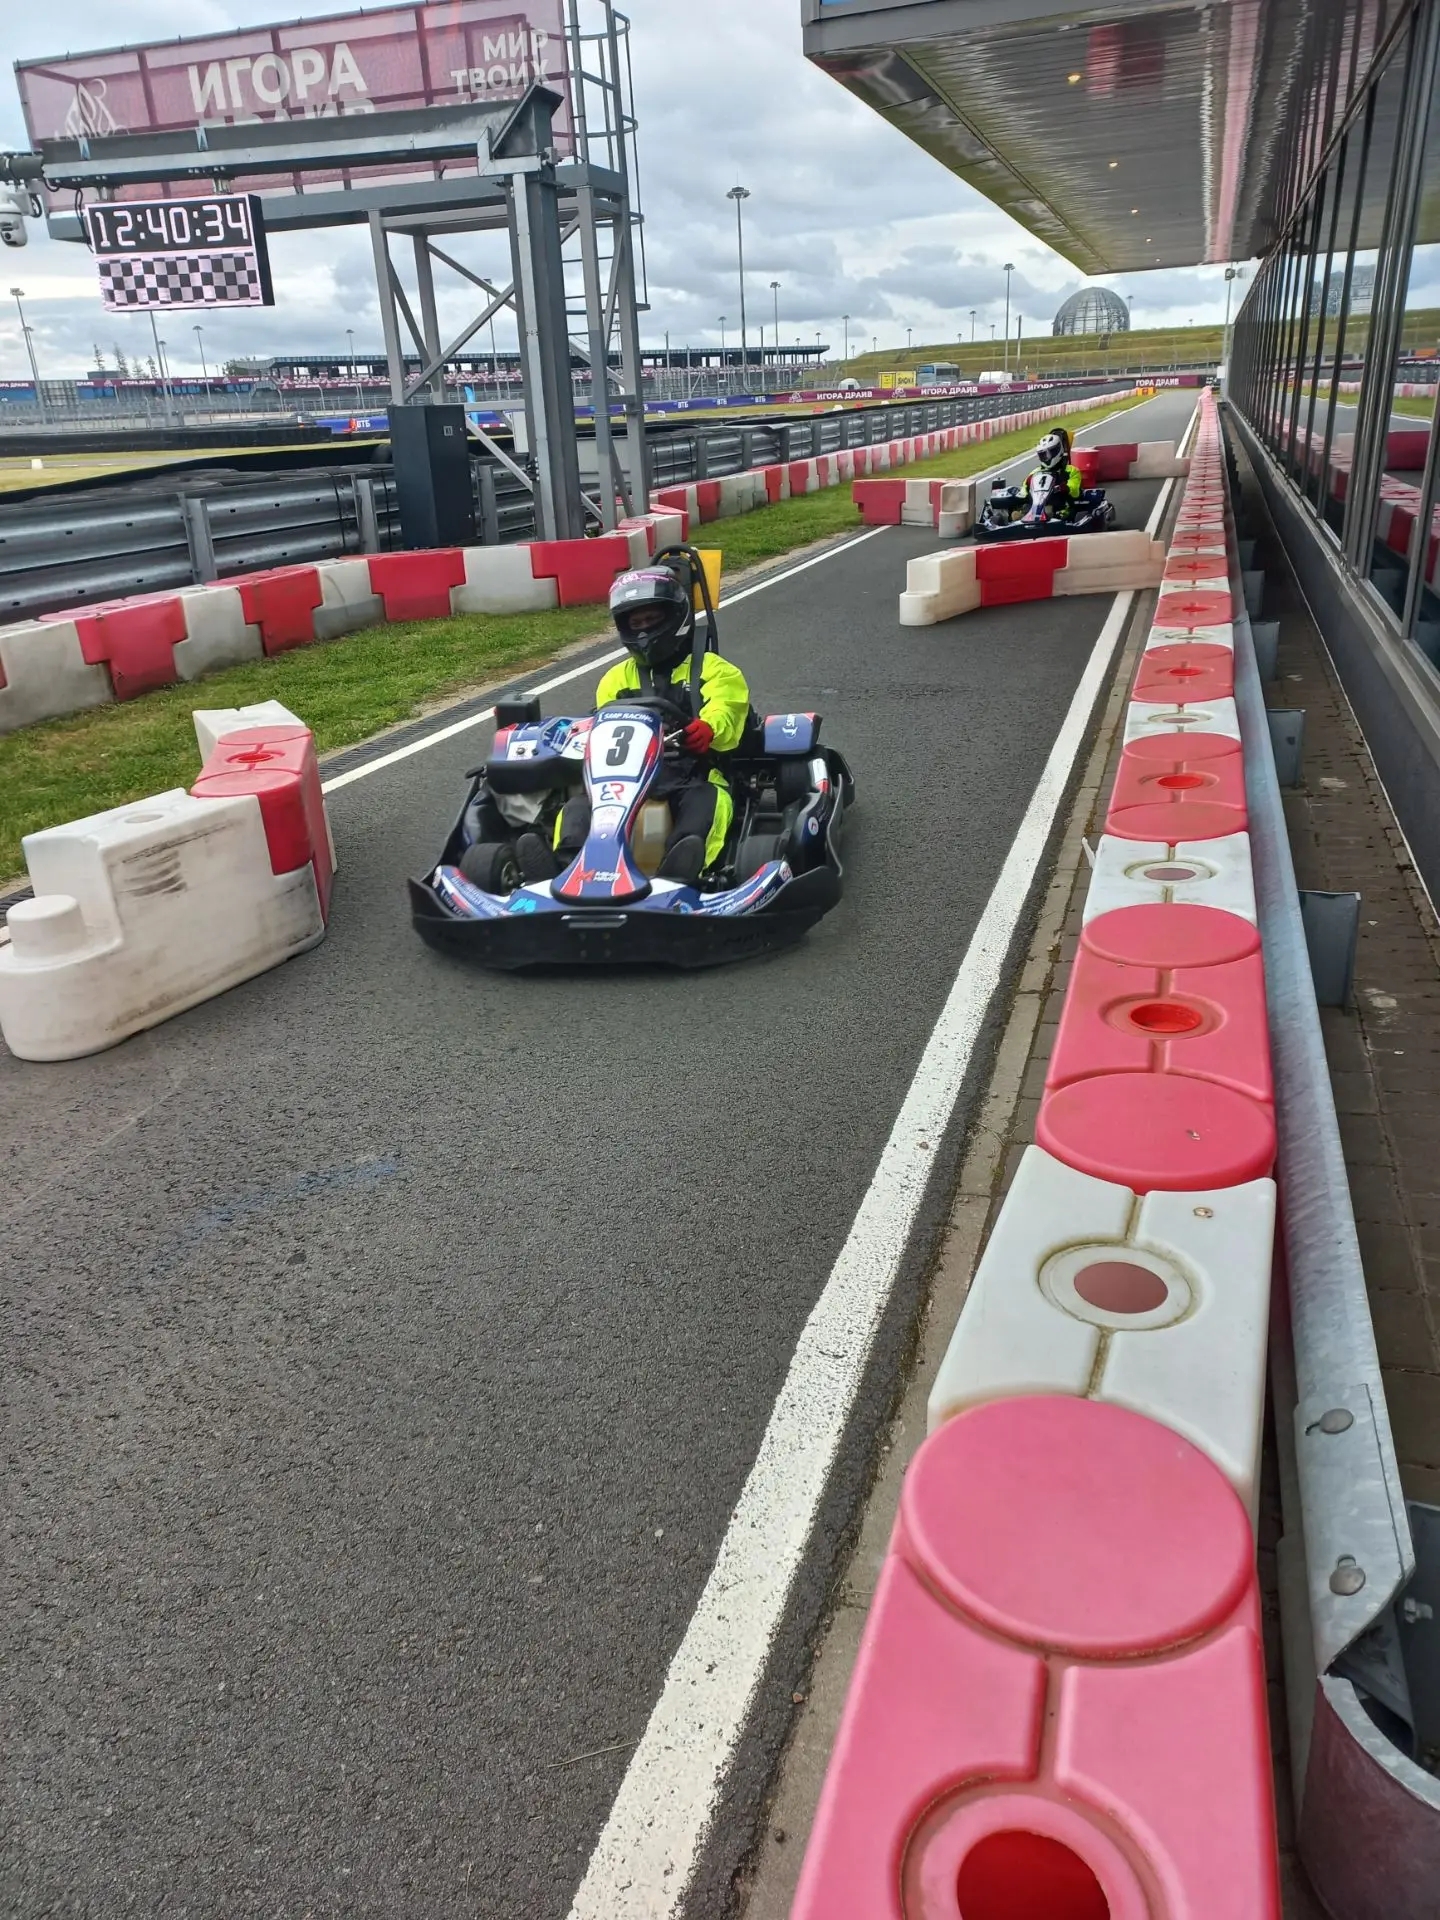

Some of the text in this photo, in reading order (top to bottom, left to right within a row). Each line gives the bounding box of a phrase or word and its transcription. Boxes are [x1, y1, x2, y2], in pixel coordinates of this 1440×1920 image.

[482, 27, 549, 62] МИР
[187, 42, 369, 113] ИГОРА
[450, 58, 549, 95] ТВОИХ
[95, 202, 248, 248] 12:40:34
[816, 392, 843, 400] ИГОРА
[920, 387, 948, 396] ИГОРА
[605, 725, 635, 767] 3
